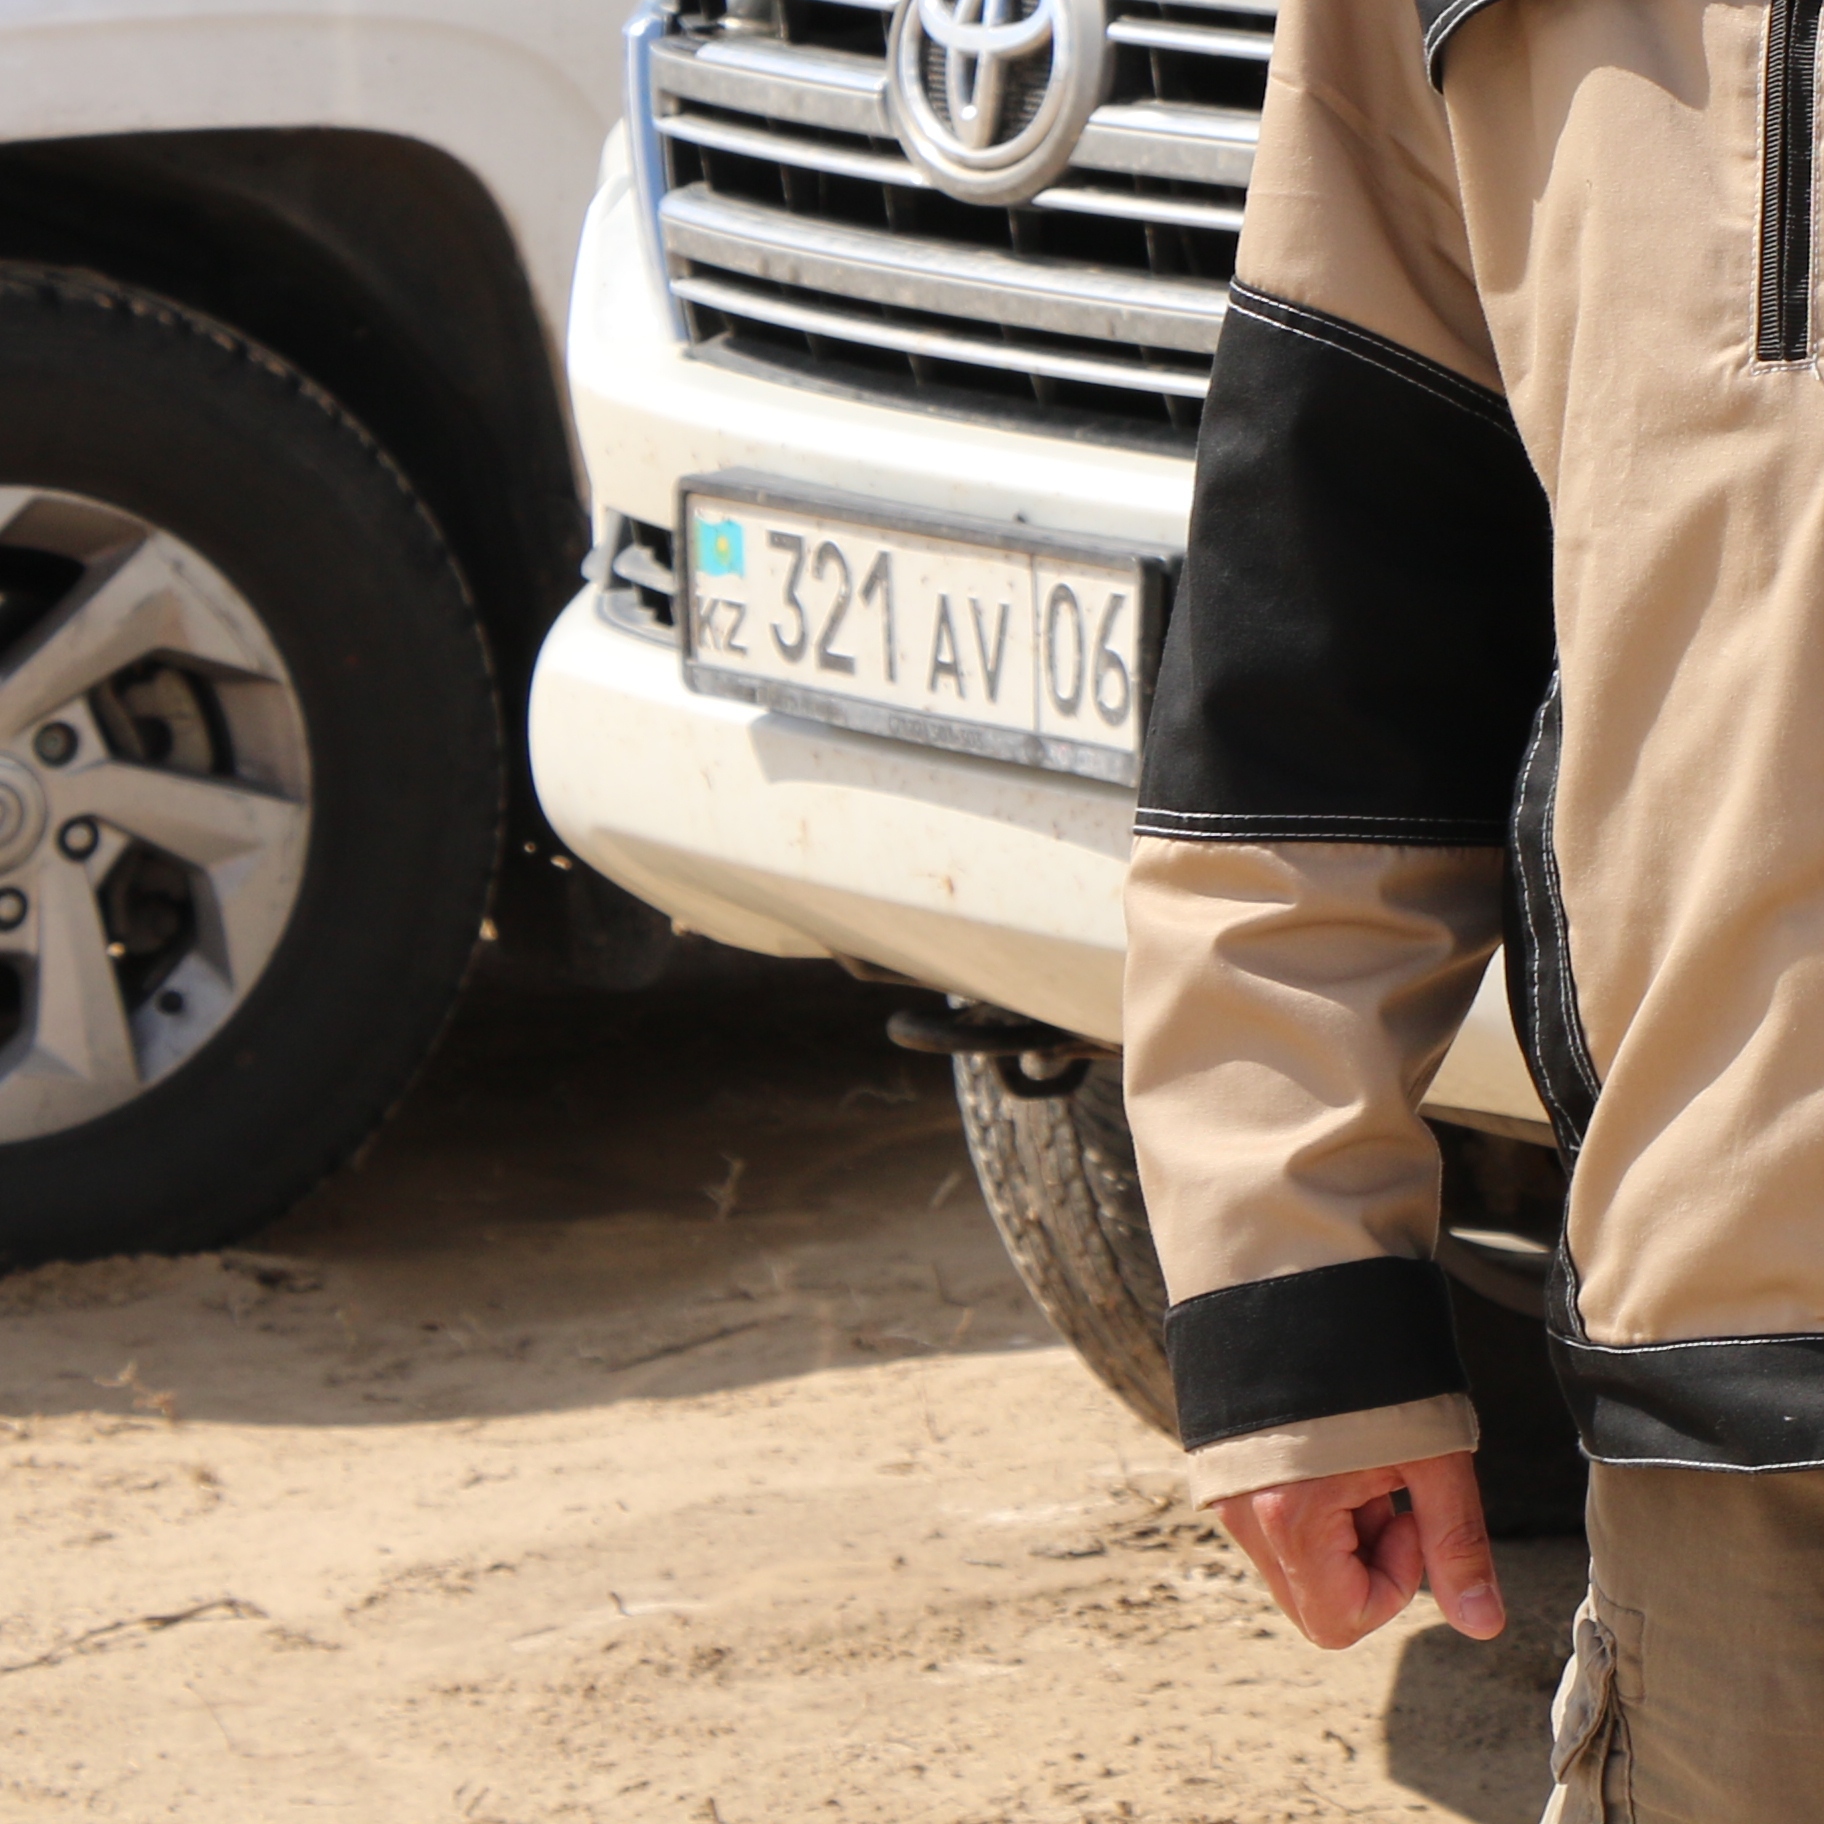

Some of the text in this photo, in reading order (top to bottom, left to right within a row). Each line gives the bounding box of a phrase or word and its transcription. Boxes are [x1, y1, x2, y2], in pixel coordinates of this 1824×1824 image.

[697, 529, 1132, 727] KZ 321 AV 06
